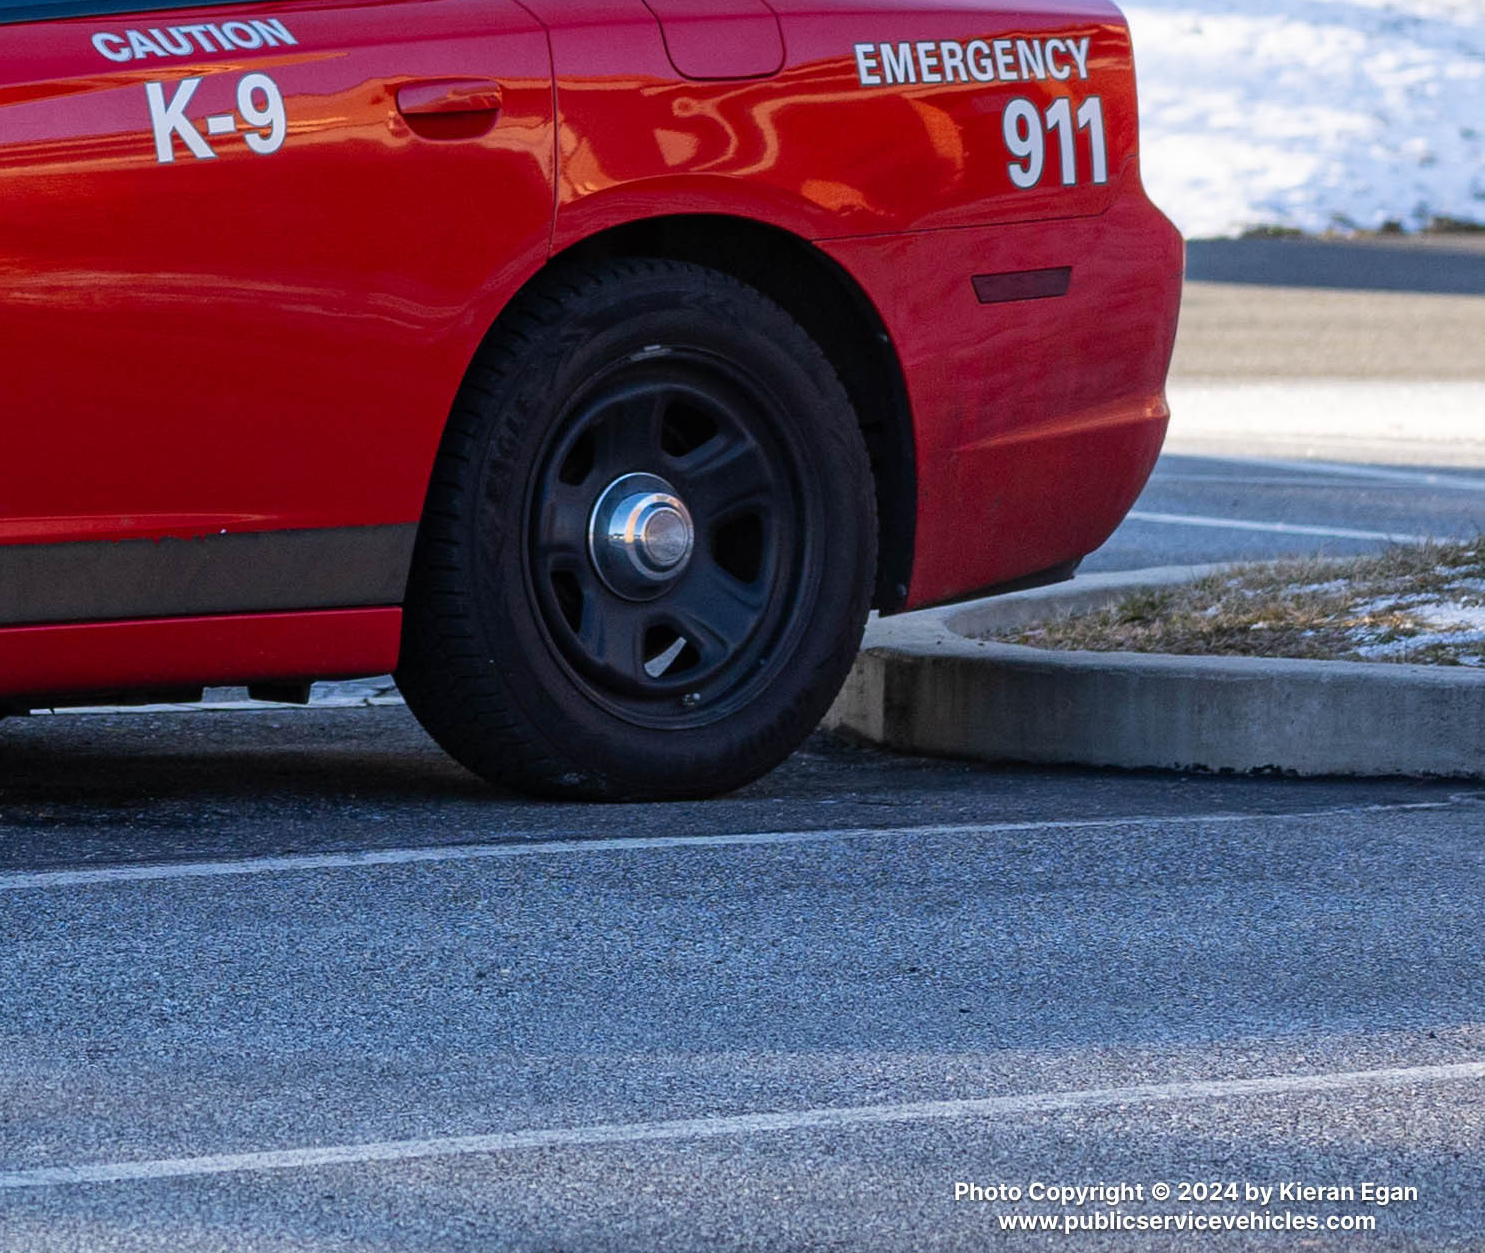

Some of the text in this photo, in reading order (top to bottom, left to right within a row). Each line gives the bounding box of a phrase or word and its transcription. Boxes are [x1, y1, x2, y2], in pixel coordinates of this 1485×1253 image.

[91, 17, 299, 63] CAUTION
[854, 37, 1090, 86] EMERGENCY
[145, 71, 287, 164] K-9
[1002, 96, 1108, 189] 911
